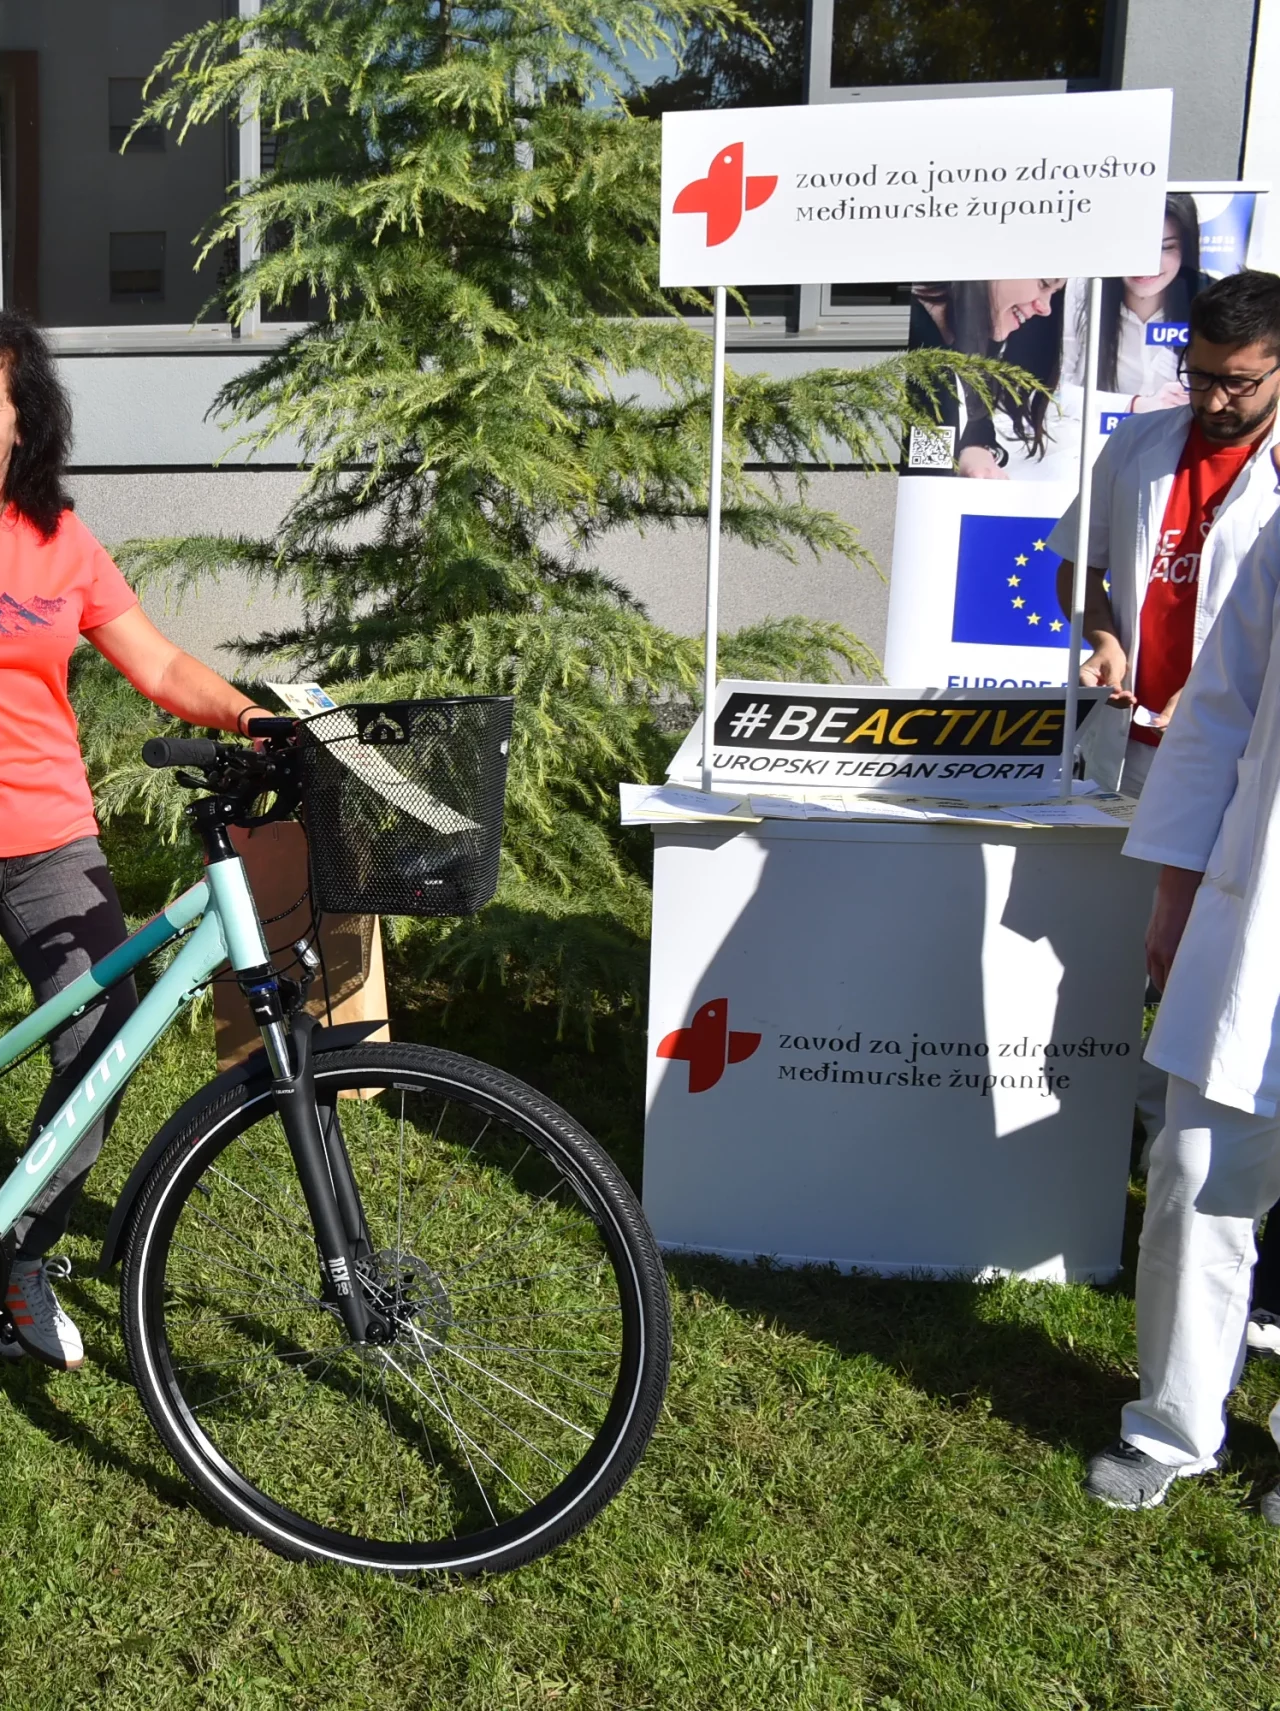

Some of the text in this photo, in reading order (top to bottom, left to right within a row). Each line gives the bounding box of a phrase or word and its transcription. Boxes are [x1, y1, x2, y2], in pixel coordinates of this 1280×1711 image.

[885, 170, 919, 187] za
[921, 161, 1008, 194] javno
[1015, 155, 1157, 182] zdravstvo
[795, 189, 1092, 225] Međimurske županije
[1149, 553, 1201, 584] ACT
[729, 702, 1066, 748] #BEACTIVE
[833, 760, 935, 779] TJEDAN
[937, 762, 1045, 780] SPORTA
[869, 1038, 902, 1055] za
[904, 1033, 990, 1064] javno
[997, 1036, 1131, 1059] zdravstvo
[777, 1061, 1070, 1097] Međimurske županije
